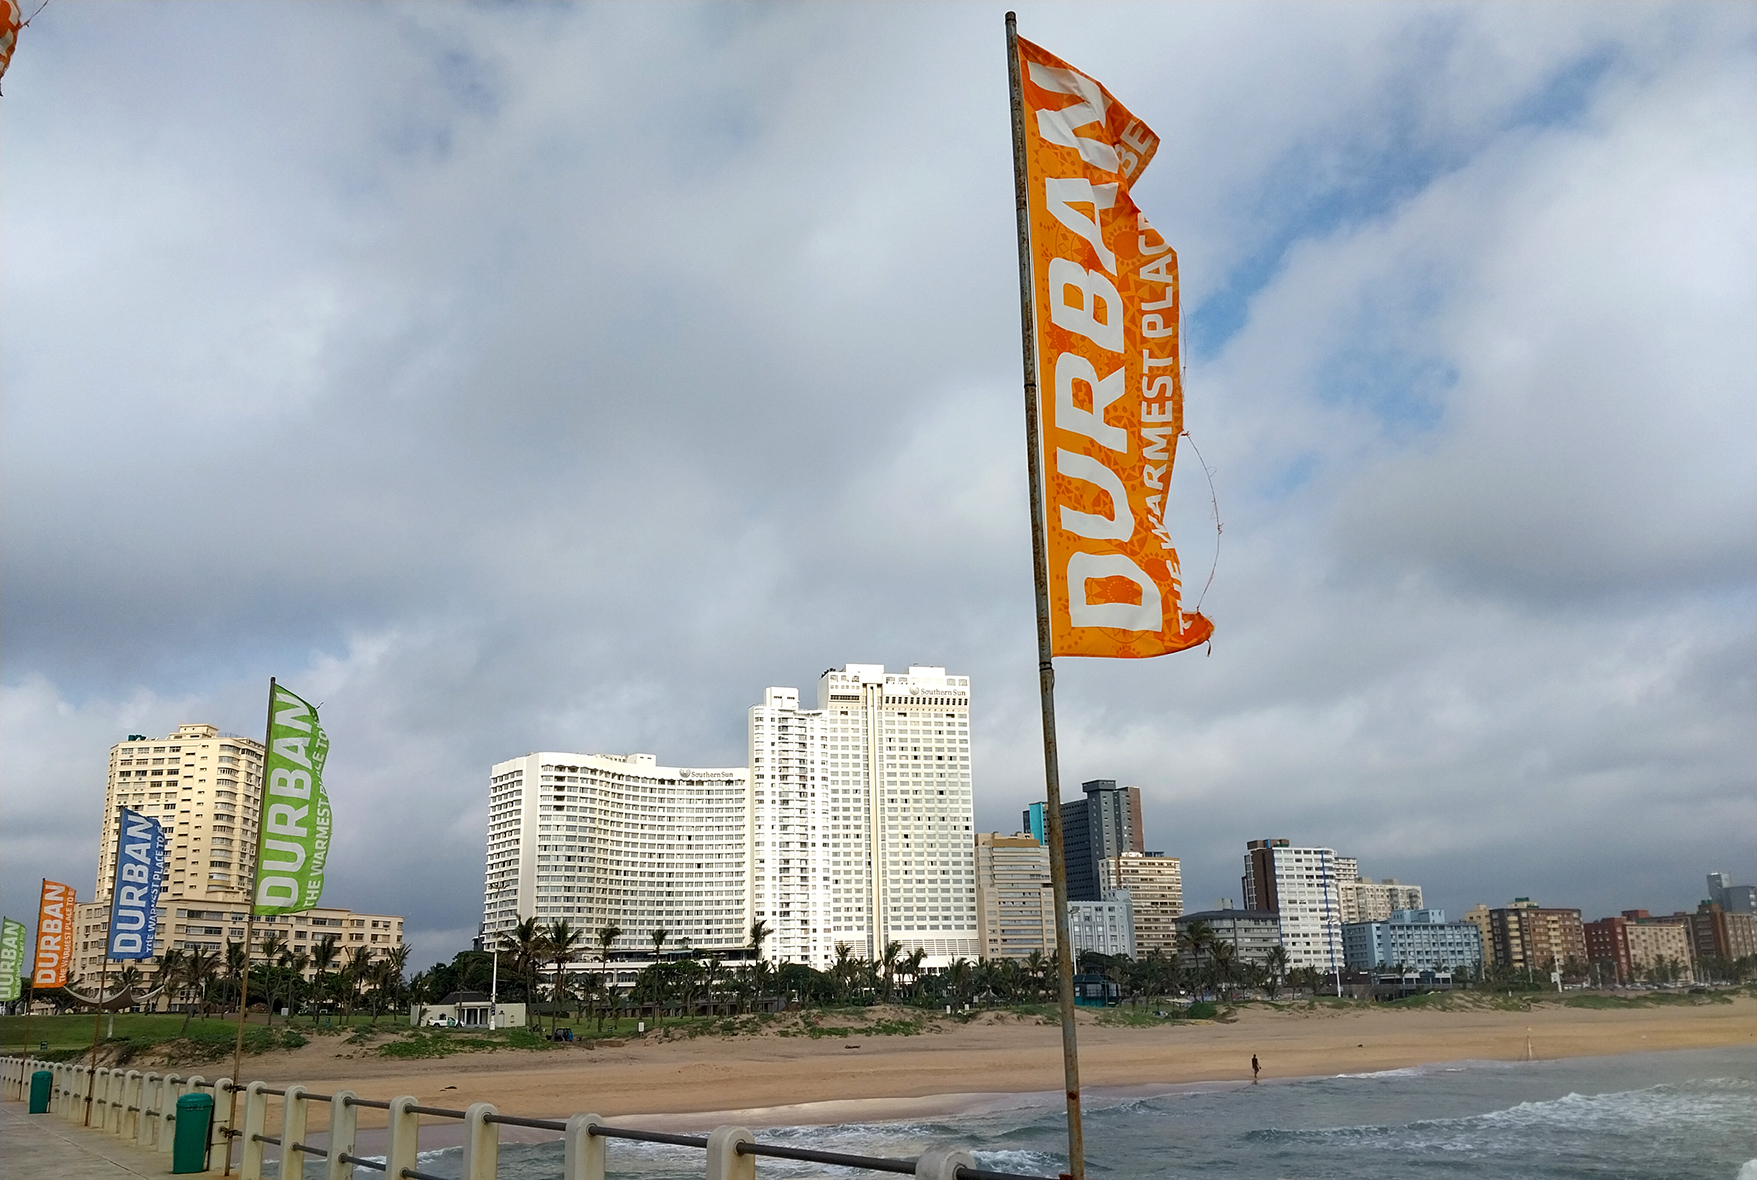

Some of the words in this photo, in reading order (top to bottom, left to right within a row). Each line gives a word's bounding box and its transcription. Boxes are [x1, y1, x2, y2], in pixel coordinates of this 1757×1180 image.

[1113, 118, 1156, 179] BE
[1027, 60, 1163, 633] DURBAN
[1139, 348, 1177, 551] WARMEST
[920, 688, 952, 696] Southern
[952, 688, 966, 696] Sun
[255, 692, 313, 908] DURBAN
[312, 751, 328, 797] PCE
[721, 770, 734, 778] Sun
[309, 797, 331, 877] WARMEST
[66, 897, 74, 906] TO
[112, 814, 154, 953] DURBAN
[146, 934, 154, 953] THE
[152, 850, 165, 881] PLACE
[302, 880, 321, 908] THE
[35, 884, 66, 984] DURBAN
[61, 931, 71, 968] WARMEST
[64, 908, 73, 930] PLACE
[0, 921, 20, 998] DURBAN
[59, 968, 67, 983] THE
